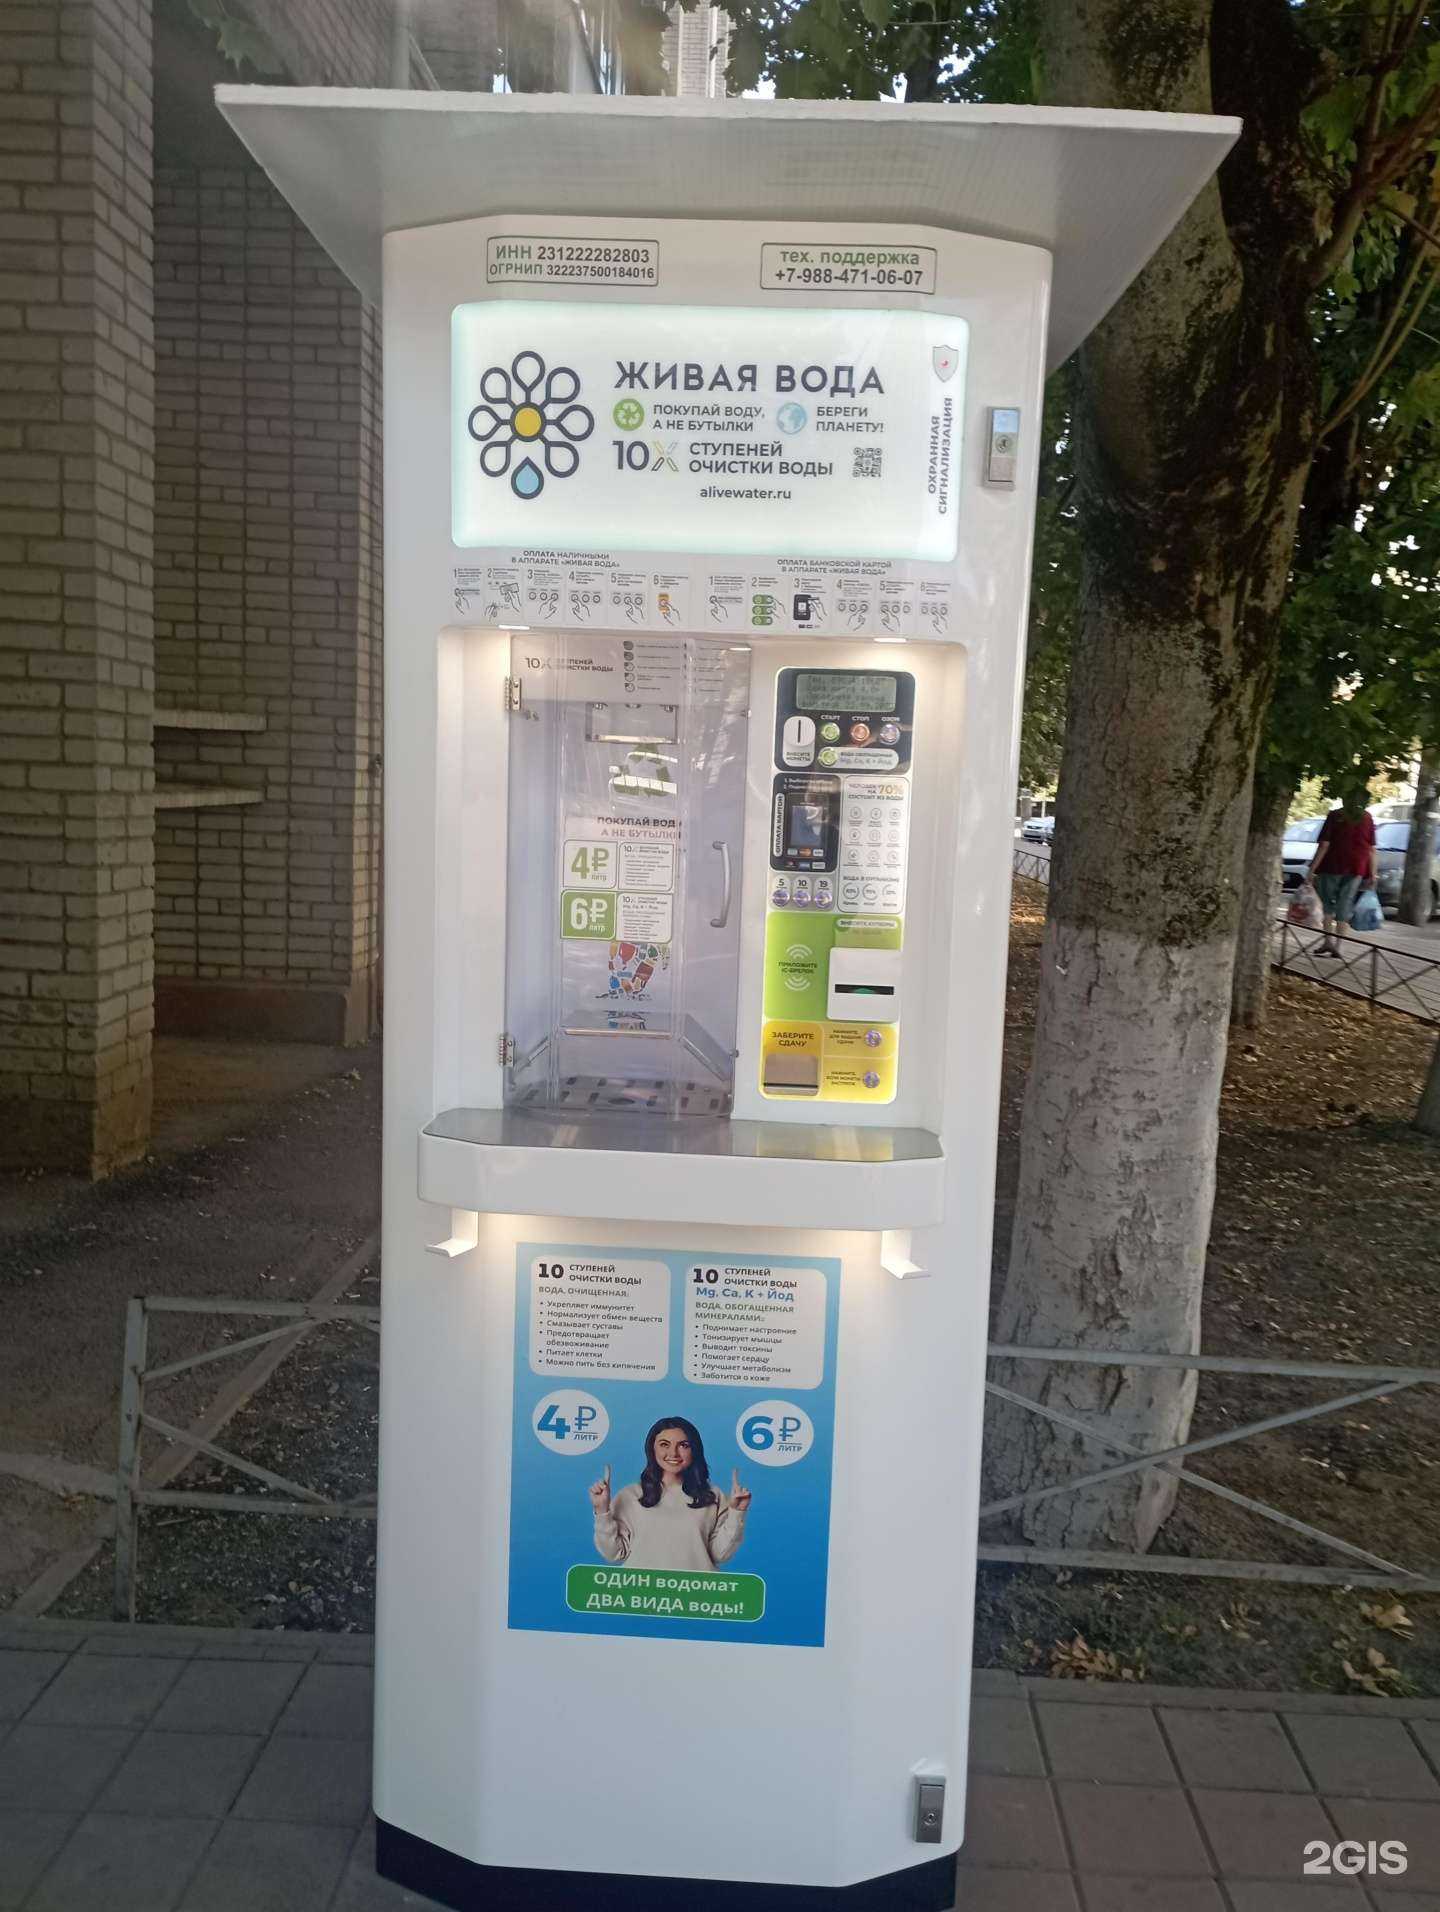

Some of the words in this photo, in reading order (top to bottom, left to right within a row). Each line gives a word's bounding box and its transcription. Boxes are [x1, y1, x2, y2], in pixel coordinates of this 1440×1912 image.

[496, 245, 532, 260] ИНН
[537, 246, 650, 263] 231222282803
[780, 251, 814, 263] тех.
[821, 252, 920, 267] поддержка
[489, 263, 543, 276] ОГРНИП
[547, 264, 654, 279] 322237500184016
[776, 268, 923, 286] +7-988-471-06-07
[614, 361, 757, 391] ЖИВАЯ
[776, 365, 884, 398] ВОДА
[654, 403, 720, 417] ПОКУПАЙ
[724, 406, 765, 418] ВОДУ,
[817, 406, 868, 417] БЕРЕГИ
[653, 420, 662, 430] А
[667, 420, 684, 430] НЕ
[688, 421, 754, 432] БУТЫЛКИ
[816, 421, 884, 433] ПЛАНЕТУ!
[690, 441, 782, 457] СТУПЕНЕЙ
[928, 416, 940, 494] ОХРАННАЯ
[939, 397, 953, 514] СИГНАЛИЗАЦИЯ
[689, 460, 773, 474] ОЧИСТКИ
[779, 463, 833, 477] ВОДЫ
[700, 486, 791, 500] alivewater.ru
[523, 550, 555, 558] ОПЛАТА
[526, 658, 540, 669] 10
[597, 816, 650, 827] ПОКУПАЙ
[772, 1032, 814, 1040] ЗАБЕРИТЕ
[779, 1039, 807, 1047] СДАЧУ
[539, 1263, 564, 1279] 10
[570, 1264, 615, 1273] СТУПЕНЕЙ
[725, 1268, 770, 1277] СТУПЕНЕЙ
[570, 1275, 612, 1283] ОЧИСТКИ
[615, 1277, 642, 1285] ВОДЫ
[693, 1268, 718, 1284] 10
[724, 1278, 767, 1287] ОЧИСТКИ
[770, 1280, 797, 1289] ВОДЫ
[767, 1288, 794, 1302] Йод
[547, 1300, 588, 1310] Укрепляет
[602, 1313, 627, 1321] обмен
[547, 1320, 589, 1328] Смазывает
[546, 1349, 574, 1357] Питает
[574, 1433, 599, 1441] ЛИТР
[777, 1443, 803, 1452] ЛИТР
[594, 1572, 650, 1588] ОДИН
[656, 1576, 739, 1593] водомат
[587, 1593, 625, 1609] ДВА
[631, 1596, 684, 1613] ВИДА
[689, 1601, 744, 1615] воды!
